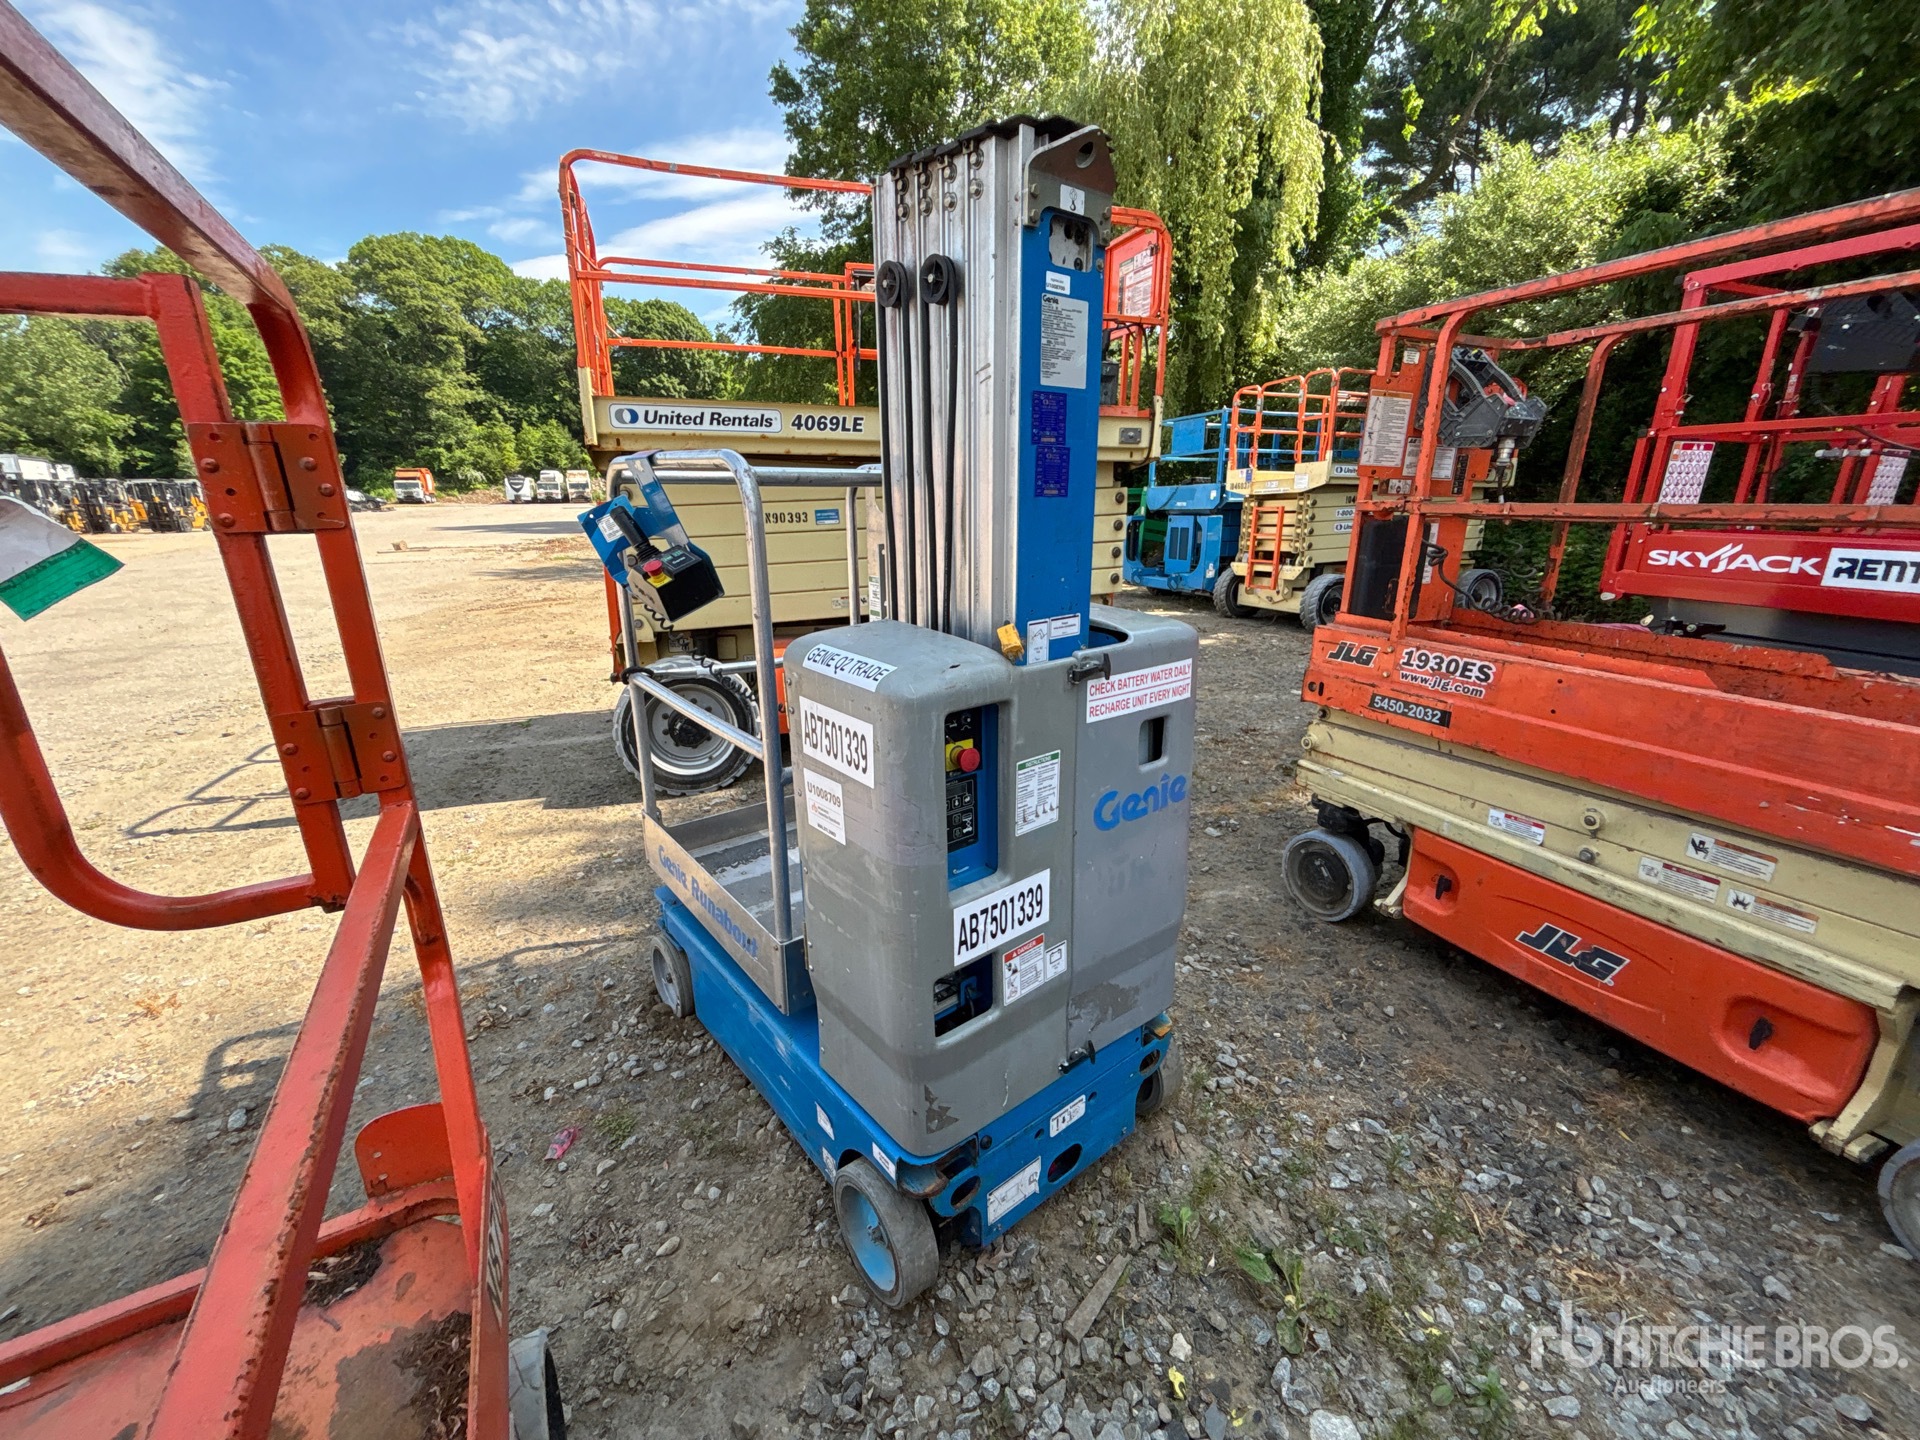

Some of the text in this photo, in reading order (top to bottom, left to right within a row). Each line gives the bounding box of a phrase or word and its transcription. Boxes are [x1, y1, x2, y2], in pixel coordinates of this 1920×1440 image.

[1043, 294, 1059, 304] Genie
[644, 410, 774, 428] United Rentals
[791, 414, 865, 433] 4069LE
[1647, 543, 1822, 576] SKYJACK
[807, 647, 890, 682] GENIE Q2 TRADE
[1327, 641, 1379, 667] JLG
[1401, 649, 1493, 683] 1930ES
[1089, 663, 1192, 697] CHECK BATTERY WATER DAILY
[1400, 671, 1484, 698] www.jlg.com
[1089, 683, 1191, 717] RECHARGE UNIT EVERY NIGHT
[1374, 696, 1441, 724] 5450-2032
[804, 710, 868, 775] AB7501339
[807, 781, 841, 808] U1008709
[1093, 773, 1187, 832] Genie
[658, 844, 759, 958] Genie Runabout
[957, 883, 1043, 956] AB7501339
[1017, 940, 1036, 955] DANGER
[1515, 922, 1631, 984] JLG
